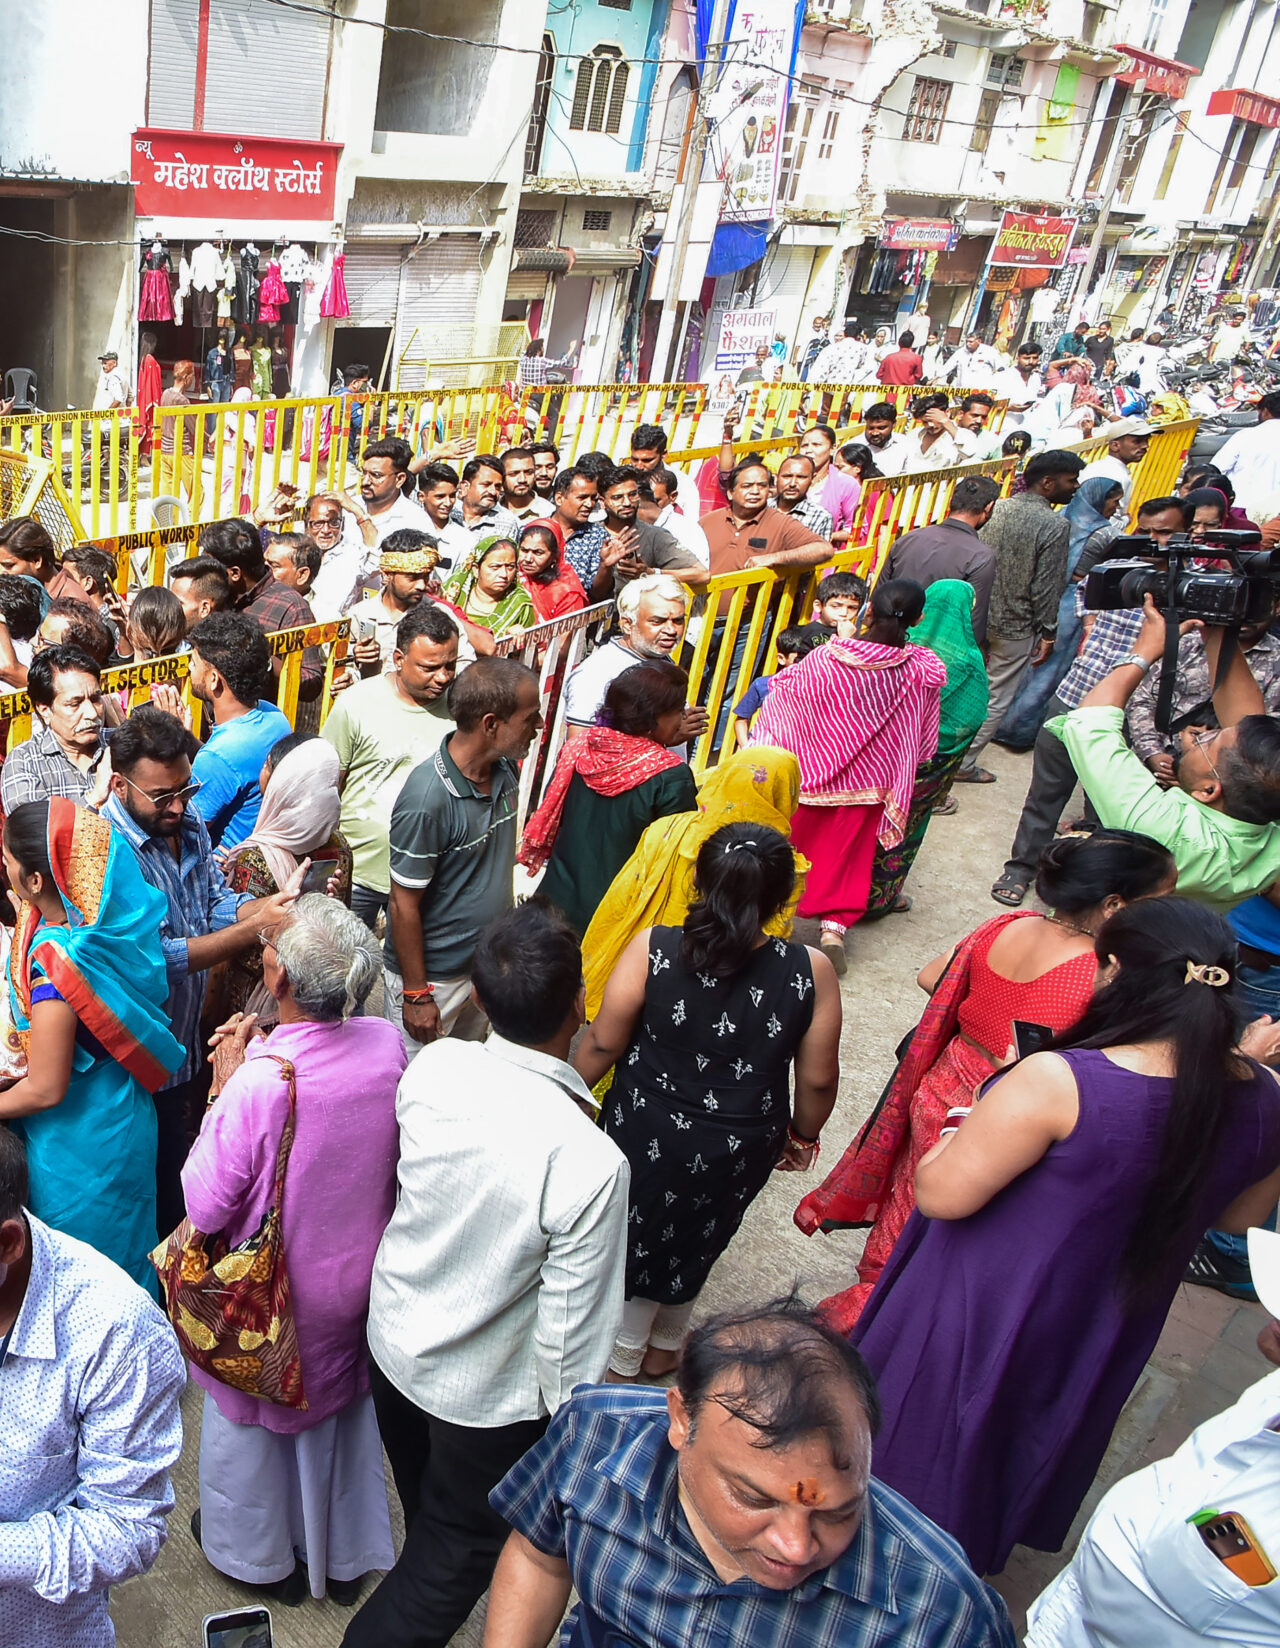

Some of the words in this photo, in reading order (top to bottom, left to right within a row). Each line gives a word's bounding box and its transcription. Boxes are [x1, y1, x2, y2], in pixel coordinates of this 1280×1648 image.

[135, 139, 154, 159] न्यू
[153, 152, 210, 190] महेश
[212, 157, 270, 191] क्लॉथ
[274, 159, 323, 194] स्टोर्स
[576, 384, 600, 393] WORKS
[602, 384, 645, 393] DEPARTMENT
[781, 383, 811, 392] PUBLIC
[814, 383, 842, 392] WORKS
[844, 384, 900, 395] DEPARTMENT
[46, 411, 79, 423] DIVISION
[80, 409, 115, 420] NEEMUCH
[120, 531, 155, 549] PUBLIC
[158, 525, 195, 544] WORKS
